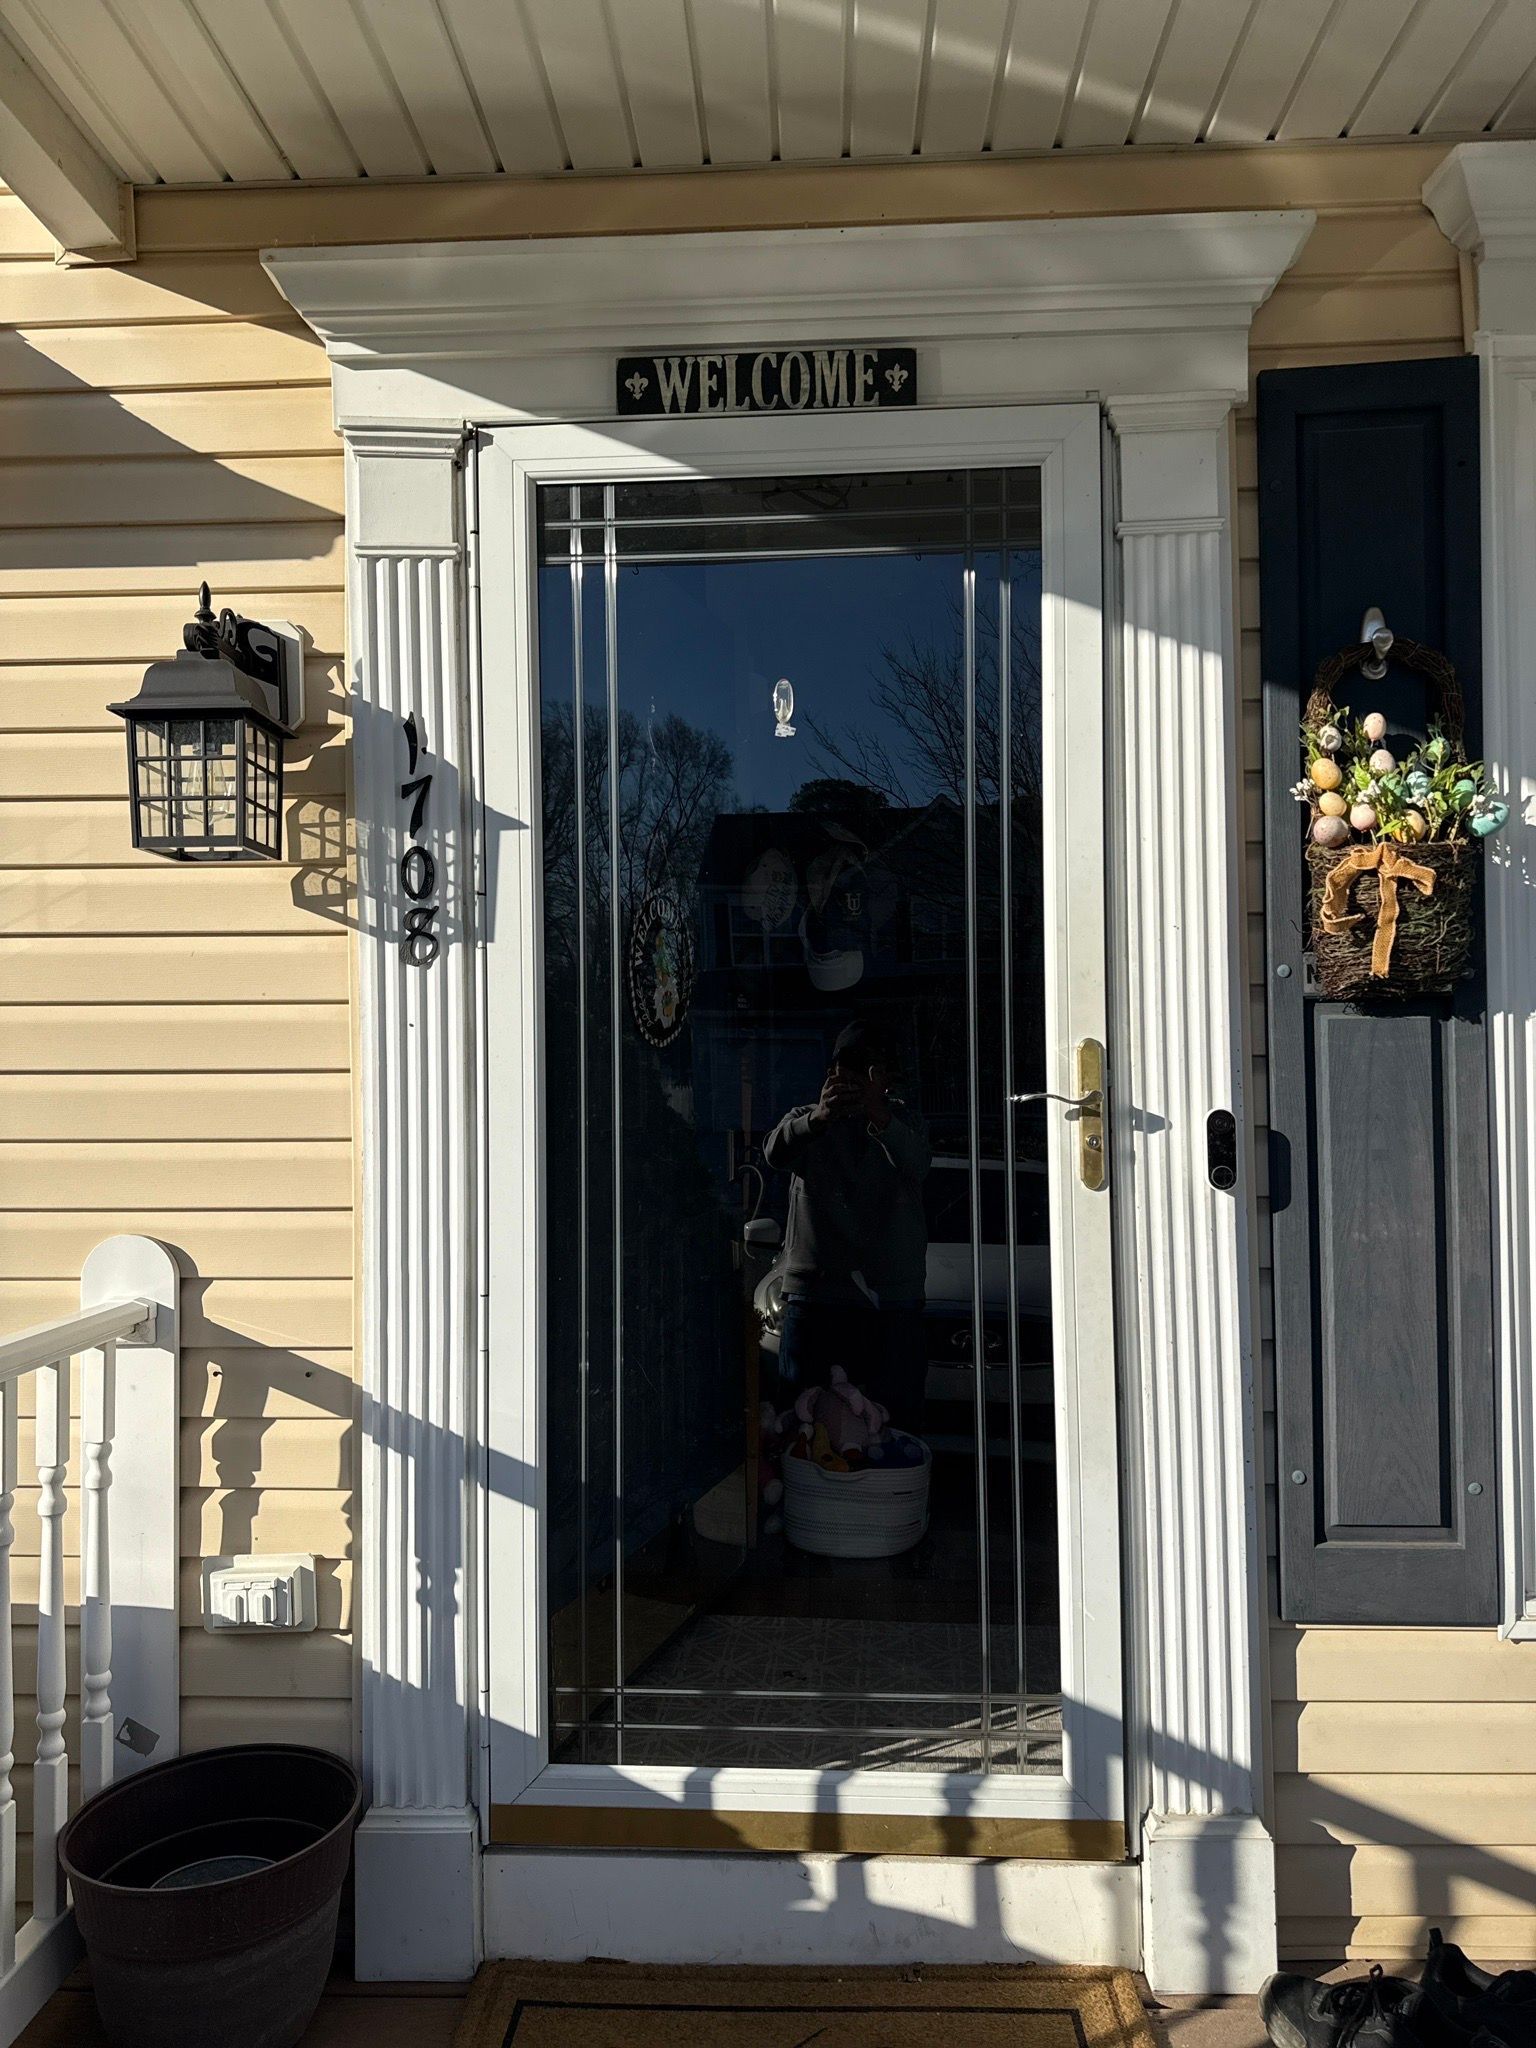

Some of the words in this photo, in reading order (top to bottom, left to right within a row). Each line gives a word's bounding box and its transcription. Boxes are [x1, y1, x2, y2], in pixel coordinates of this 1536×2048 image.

[653, 349, 880, 414] WELCOME
[400, 711, 439, 968] 1708
[634, 898, 682, 967] WELCOME
